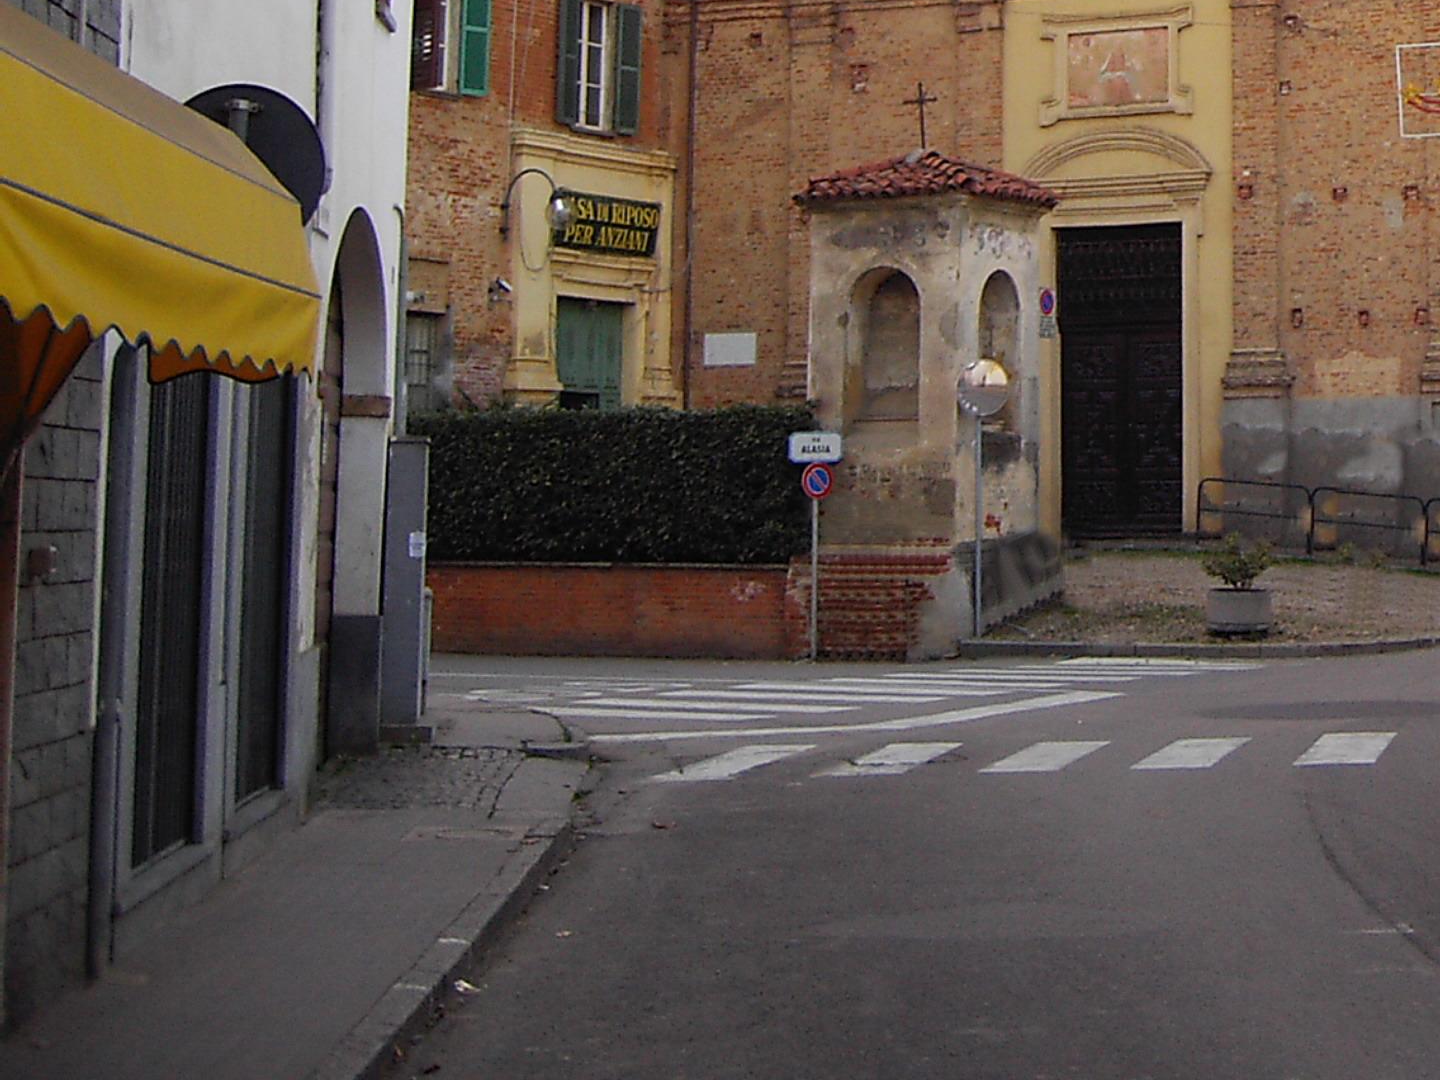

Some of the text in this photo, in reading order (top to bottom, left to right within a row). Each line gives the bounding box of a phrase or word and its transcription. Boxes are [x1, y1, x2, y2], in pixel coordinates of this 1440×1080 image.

[596, 203, 609, 222] DI
[611, 203, 659, 228] RIPOSO
[563, 224, 649, 252] PER ANZIANI
